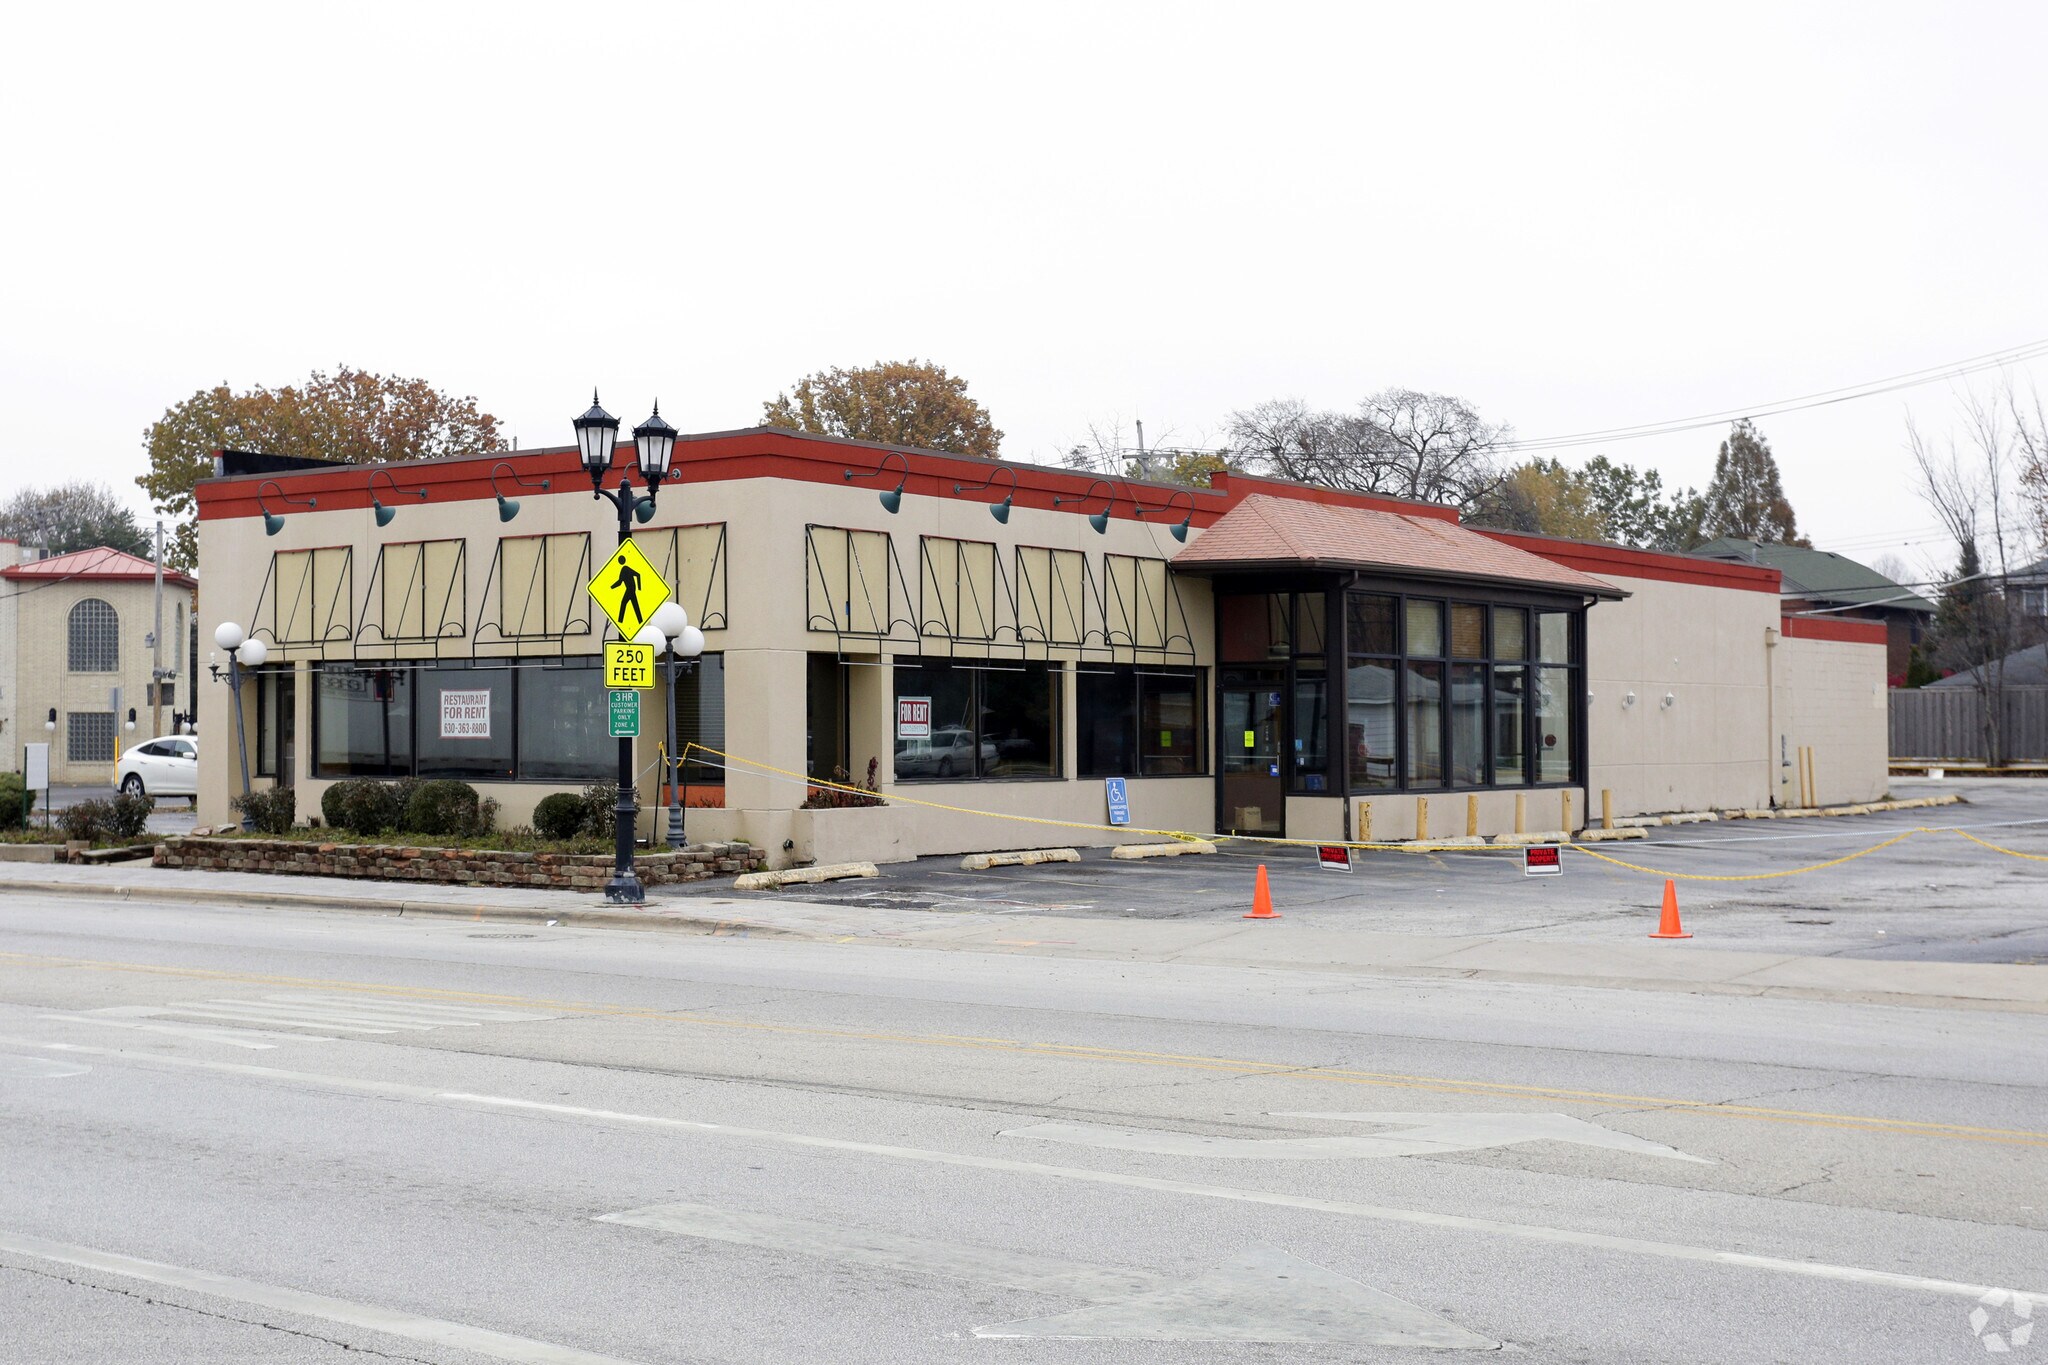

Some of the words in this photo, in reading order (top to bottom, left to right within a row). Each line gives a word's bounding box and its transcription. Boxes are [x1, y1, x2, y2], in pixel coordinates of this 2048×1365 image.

[616, 649, 643, 664] 250
[613, 667, 646, 681] FEET
[444, 694, 487, 706] RESTAURANT
[615, 692, 621, 702] 3
[621, 692, 634, 702] HR
[444, 706, 463, 719] FOR
[464, 706, 487, 719] RENT
[901, 703, 912, 722] FOR
[912, 703, 928, 722] RENT
[1528, 855, 1558, 863] PROPERTY
